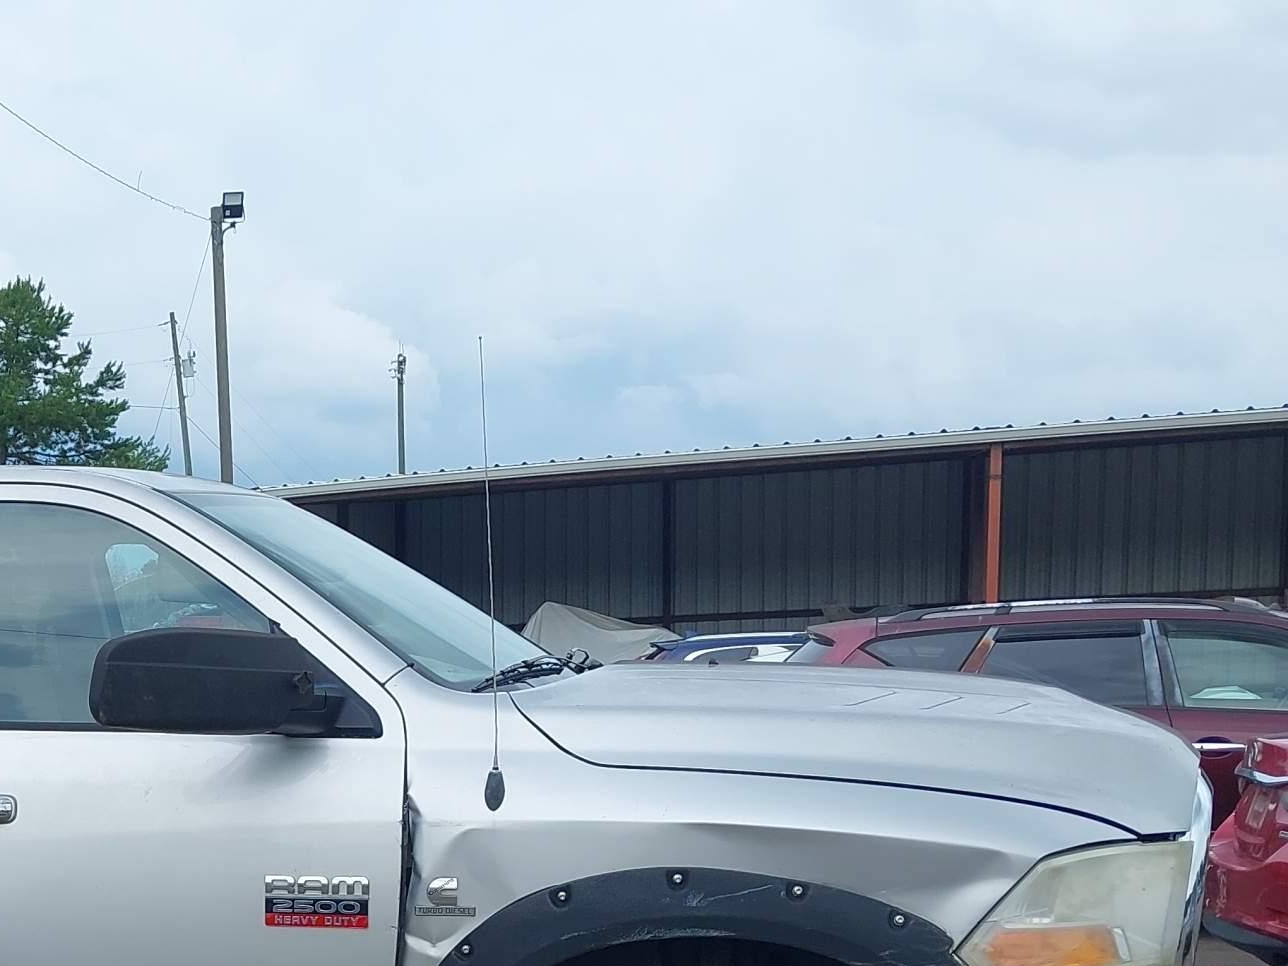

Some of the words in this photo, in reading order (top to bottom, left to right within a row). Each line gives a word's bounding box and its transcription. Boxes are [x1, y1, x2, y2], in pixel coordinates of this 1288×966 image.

[264, 875, 369, 895] RAM
[272, 899, 361, 914] 2500
[418, 906, 443, 914] TURBO
[445, 906, 473, 915] DIESEL
[274, 914, 319, 925] HEAVY
[324, 915, 360, 926] DUTY
